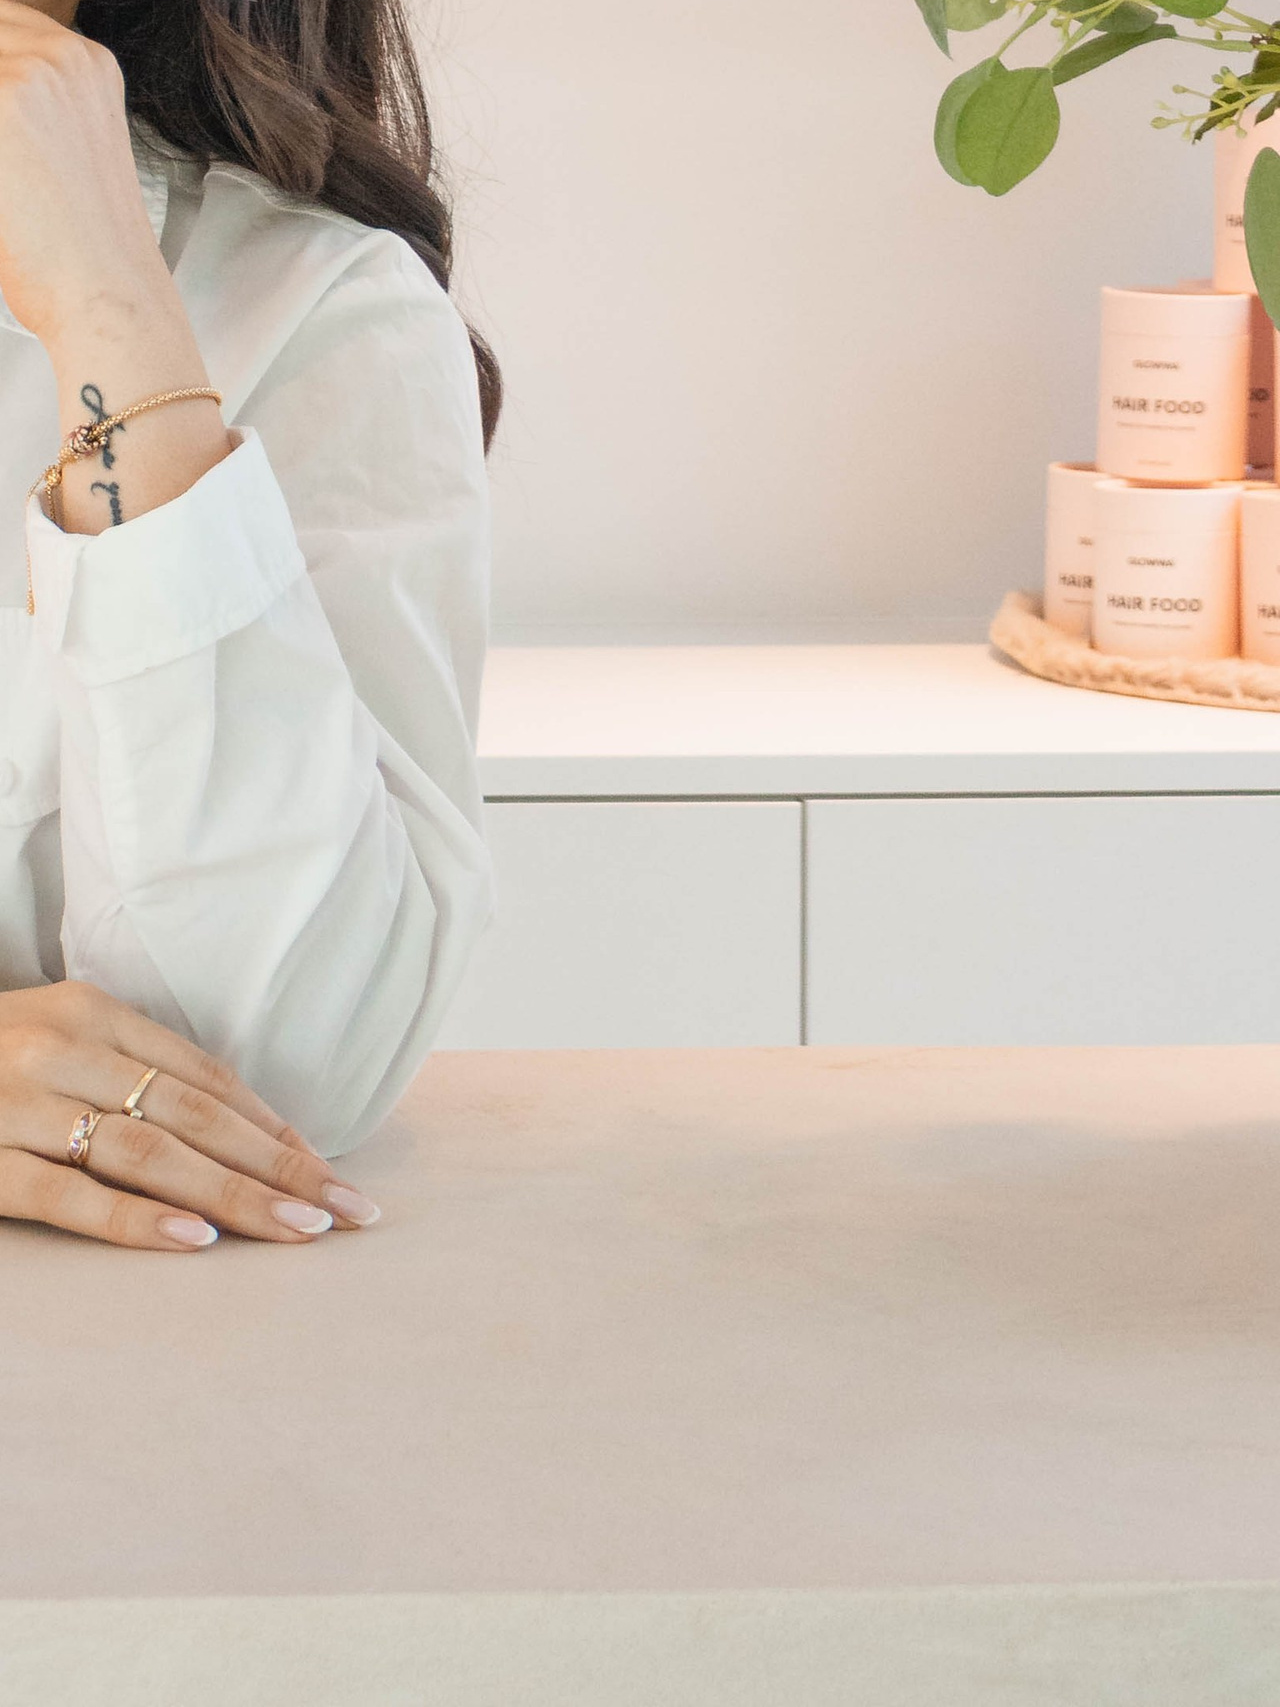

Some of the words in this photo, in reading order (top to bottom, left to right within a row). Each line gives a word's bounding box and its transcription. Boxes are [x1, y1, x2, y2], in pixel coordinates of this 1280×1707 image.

[1113, 396, 1148, 413] HAIR
[1155, 399, 1205, 415] FOOD
[1058, 572, 1094, 589] HAIR
[1107, 594, 1143, 611] HAIR
[1149, 597, 1202, 613] FOOD
